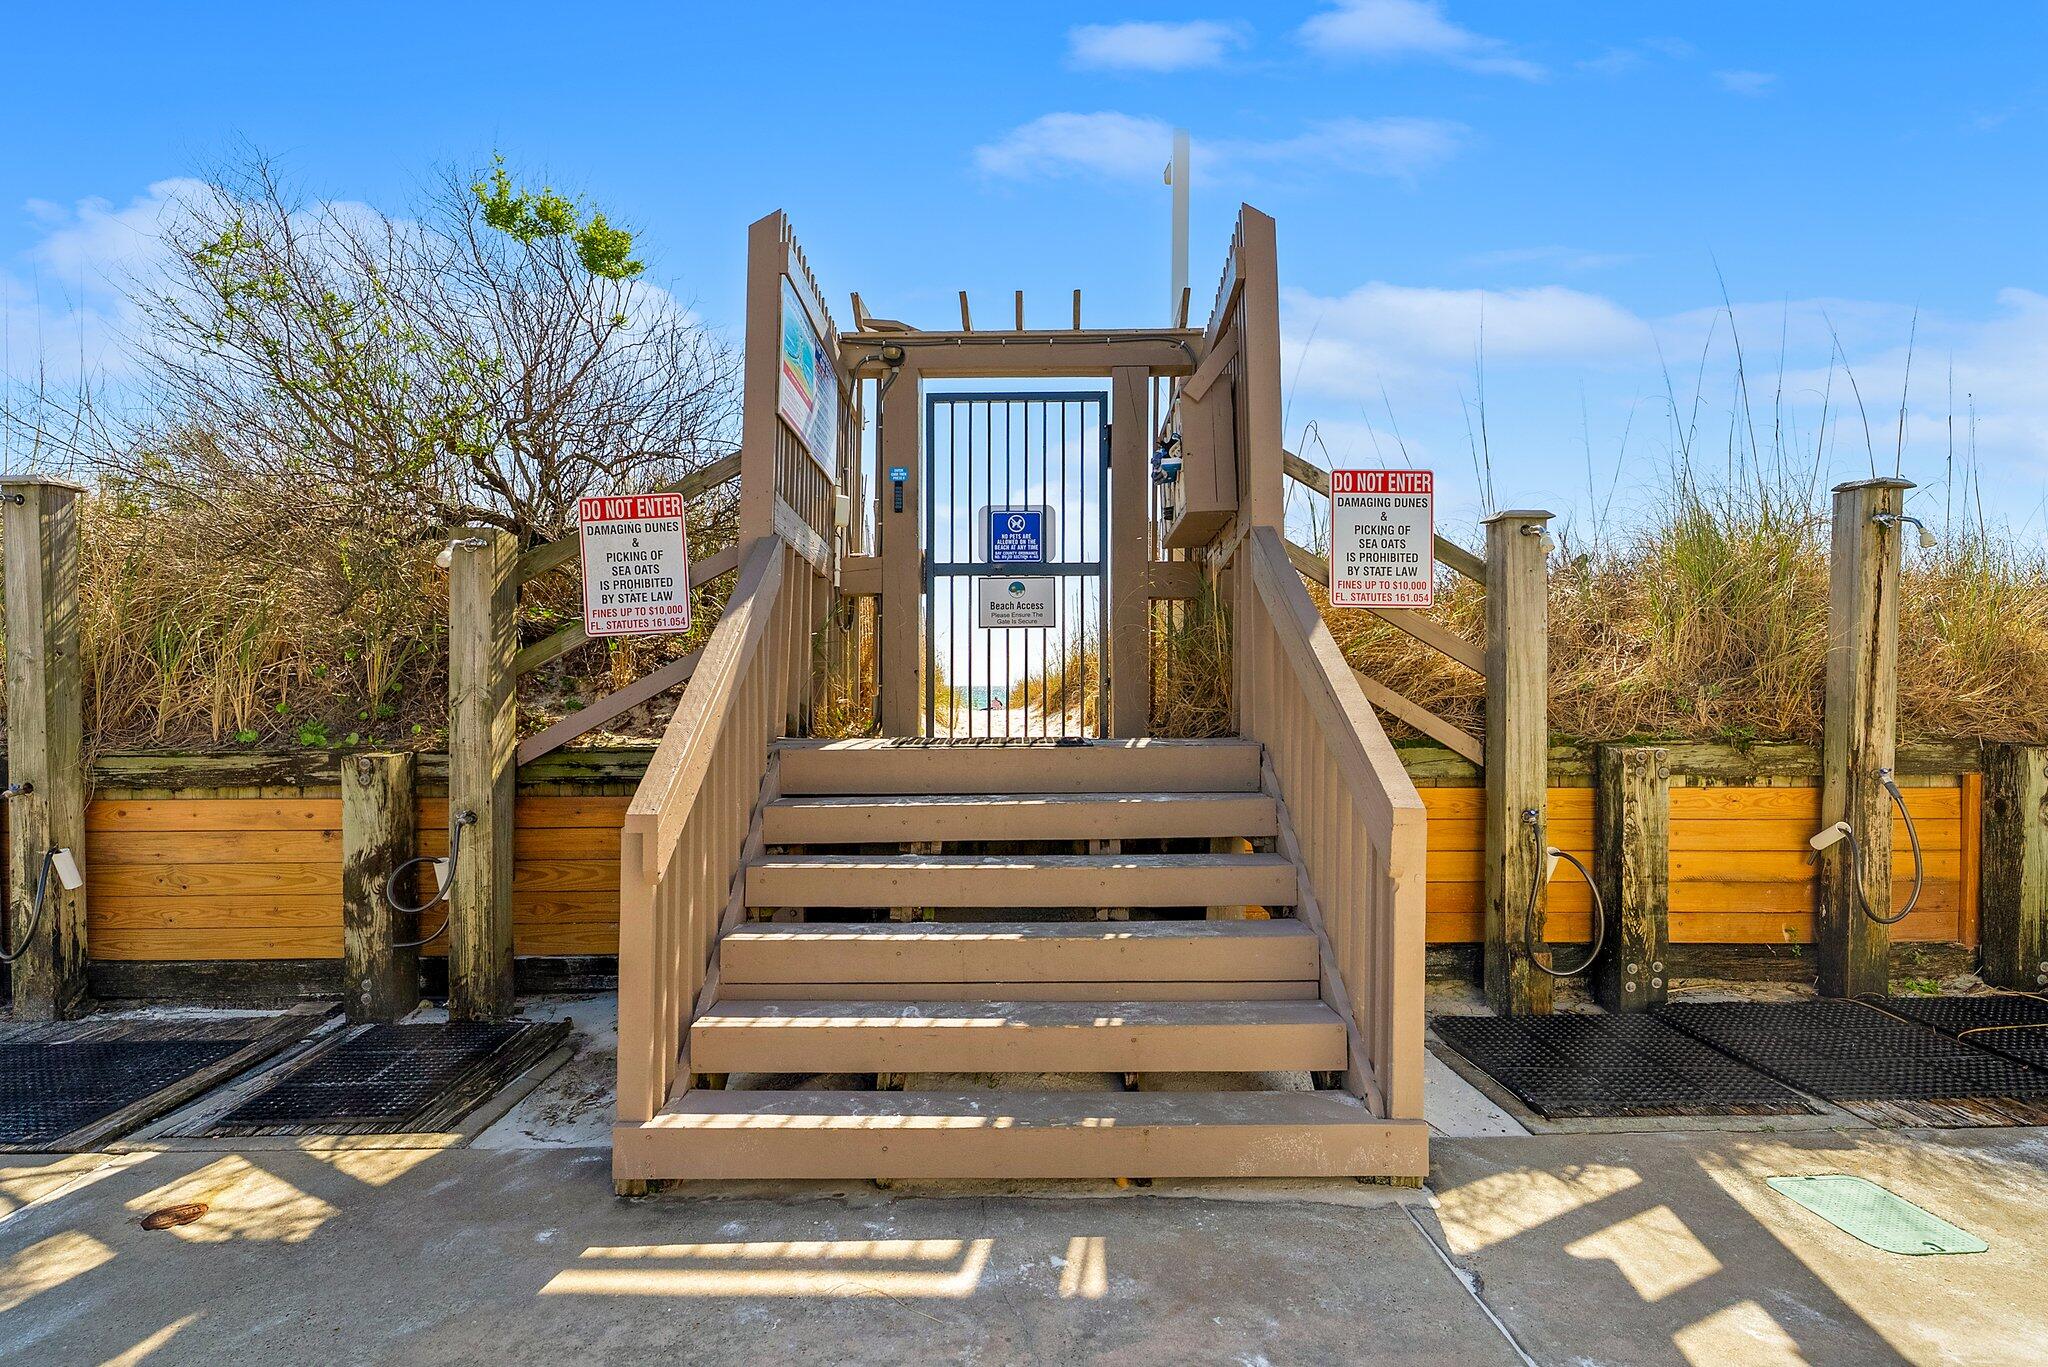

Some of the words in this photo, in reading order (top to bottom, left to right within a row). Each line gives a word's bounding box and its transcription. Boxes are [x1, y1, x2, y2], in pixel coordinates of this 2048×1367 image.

[1334, 472, 1352, 491] DO
[1357, 473, 1384, 491] NOT
[1388, 473, 1431, 492] ENTER
[1337, 497, 1391, 508] DAMAGING
[1394, 498, 1428, 508] DUNES
[582, 500, 601, 520] DO
[606, 499, 633, 519] NOT
[637, 497, 681, 517] ENTER
[1380, 511, 1388, 521] &
[587, 523, 641, 536] DAMAGING
[645, 521, 679, 533] DUNES
[1354, 525, 1394, 535] PICKING
[1397, 525, 1411, 535] OF
[632, 537, 640, 548] &
[1359, 539, 1378, 549] SEA
[1380, 539, 1406, 549] OATS
[606, 551, 647, 562] PICKING
[650, 550, 663, 560] OF
[1346, 552, 1356, 562] IS
[1360, 552, 1419, 563] PROHIBITED
[612, 565, 631, 576] SEA
[634, 564, 660, 575] OATS
[1347, 566, 1360, 576] BY
[1363, 566, 1392, 576] STATE
[1396, 567, 1418, 576] LAW
[600, 580, 610, 591] IS
[613, 577, 673, 590] PROHIBITED
[1337, 580, 1362, 590] FINES
[1365, 580, 1377, 590] UP
[1379, 580, 1390, 590] TO
[602, 594, 615, 605] BY
[618, 592, 648, 604] STATE
[651, 591, 673, 601] LAW
[1335, 592, 1348, 601] FL.
[1350, 592, 1393, 602] STATUTES
[1395, 593, 1429, 602] 161.054
[990, 602, 1015, 610] Beach
[1016, 602, 1044, 610] Access
[592, 608, 618, 618] FINES
[620, 607, 633, 617] UP
[635, 606, 646, 616] TO
[590, 621, 604, 631] FL.
[606, 618, 649, 630] STATUTES
[652, 617, 686, 628] 161.054
